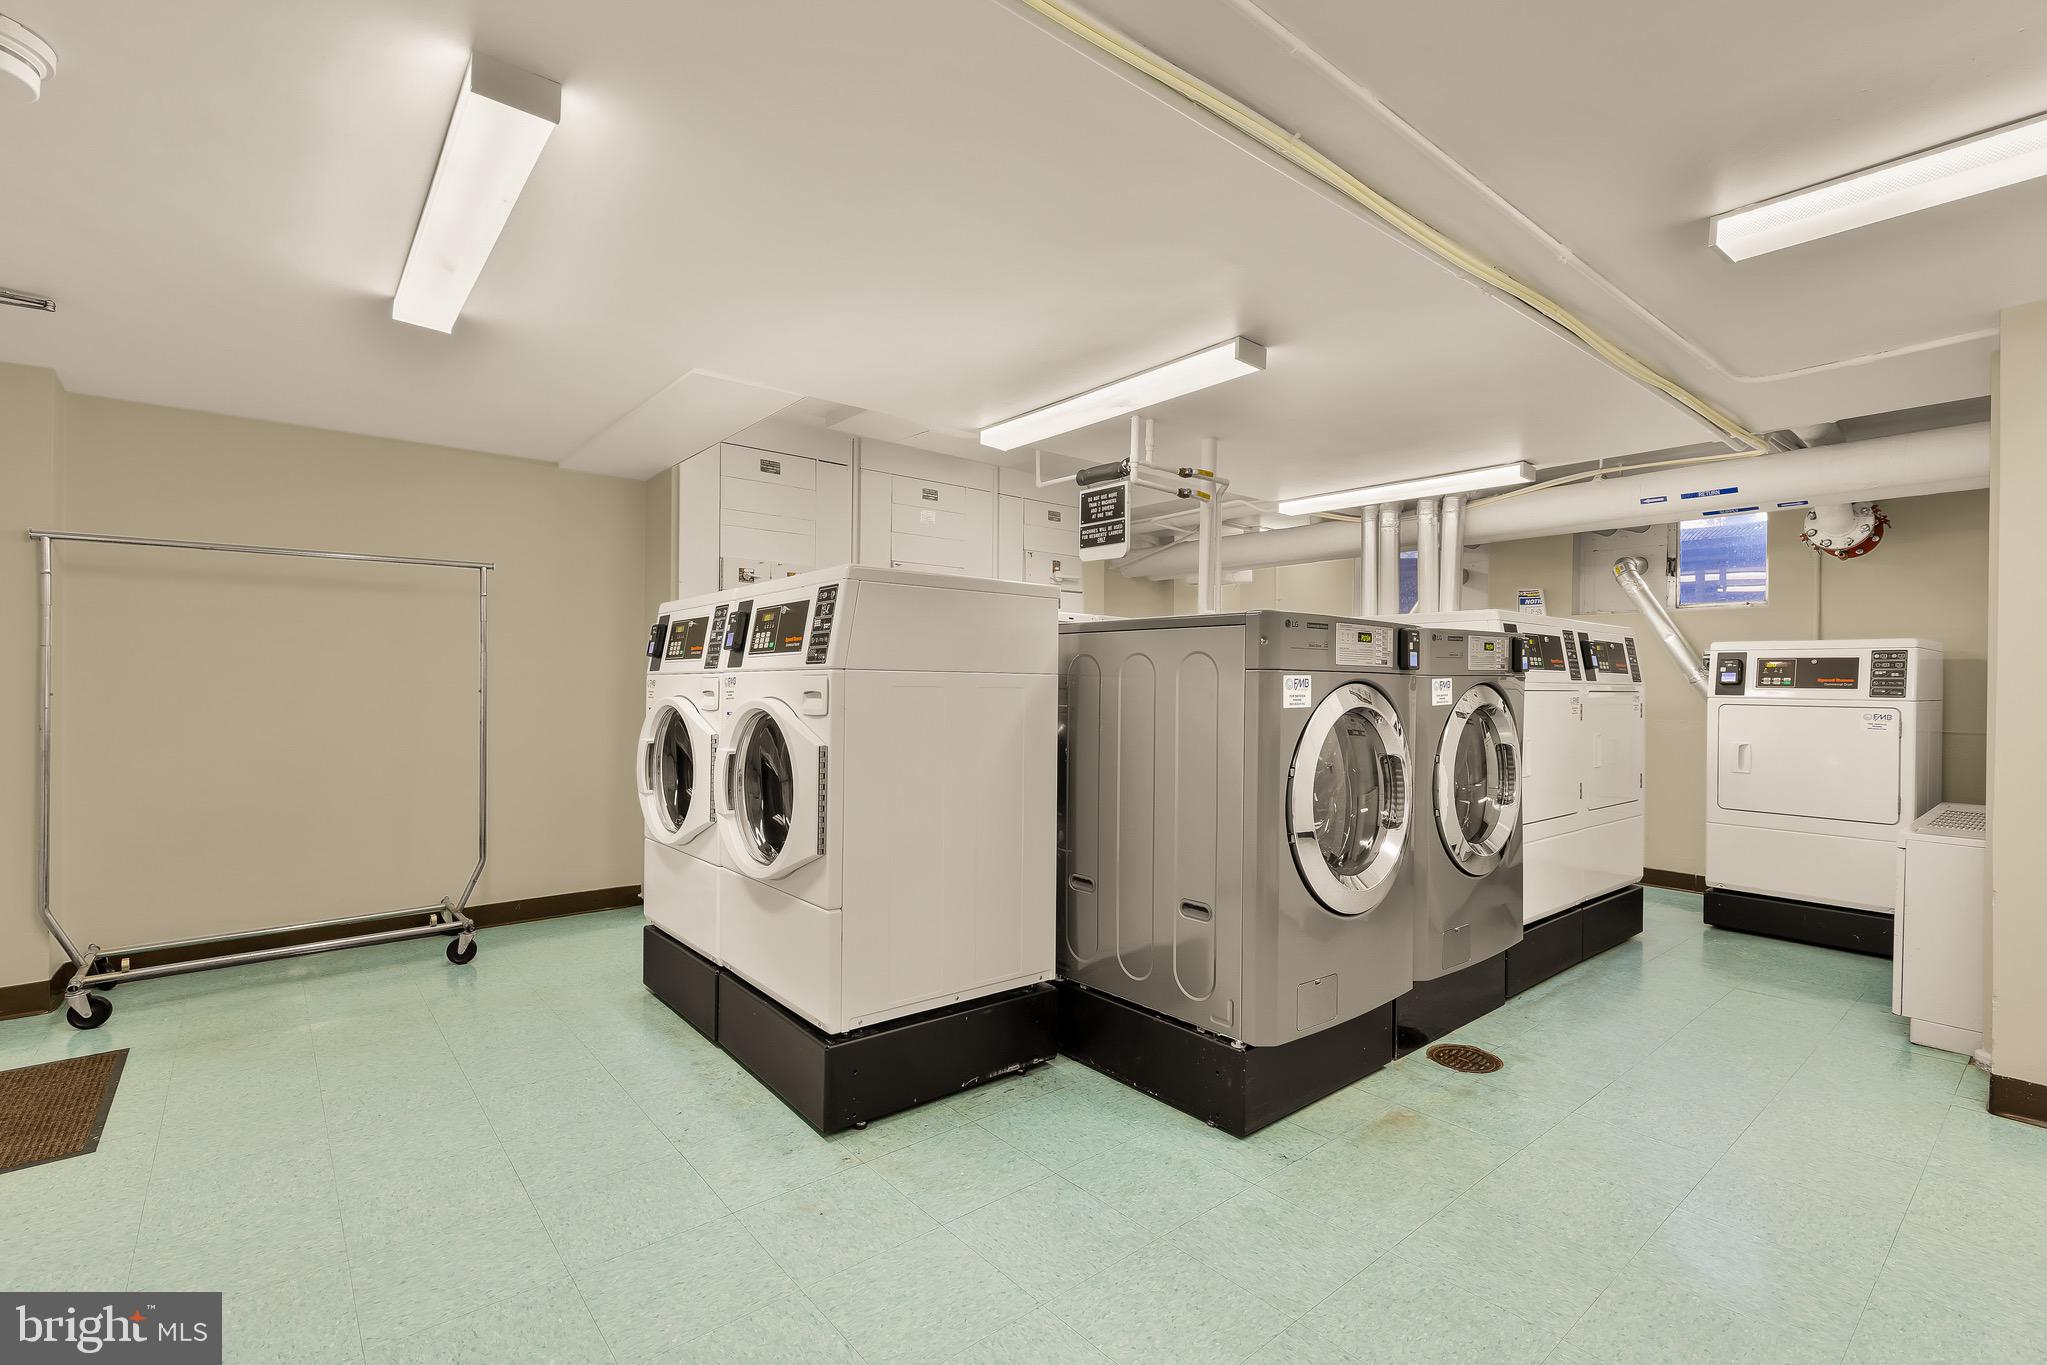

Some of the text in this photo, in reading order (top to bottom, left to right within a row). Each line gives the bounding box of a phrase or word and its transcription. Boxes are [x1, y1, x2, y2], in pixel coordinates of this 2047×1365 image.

[1698, 489, 1720, 497] RETURN
[1293, 678, 1309, 690] FMB
[1873, 713, 1893, 721] FMB
